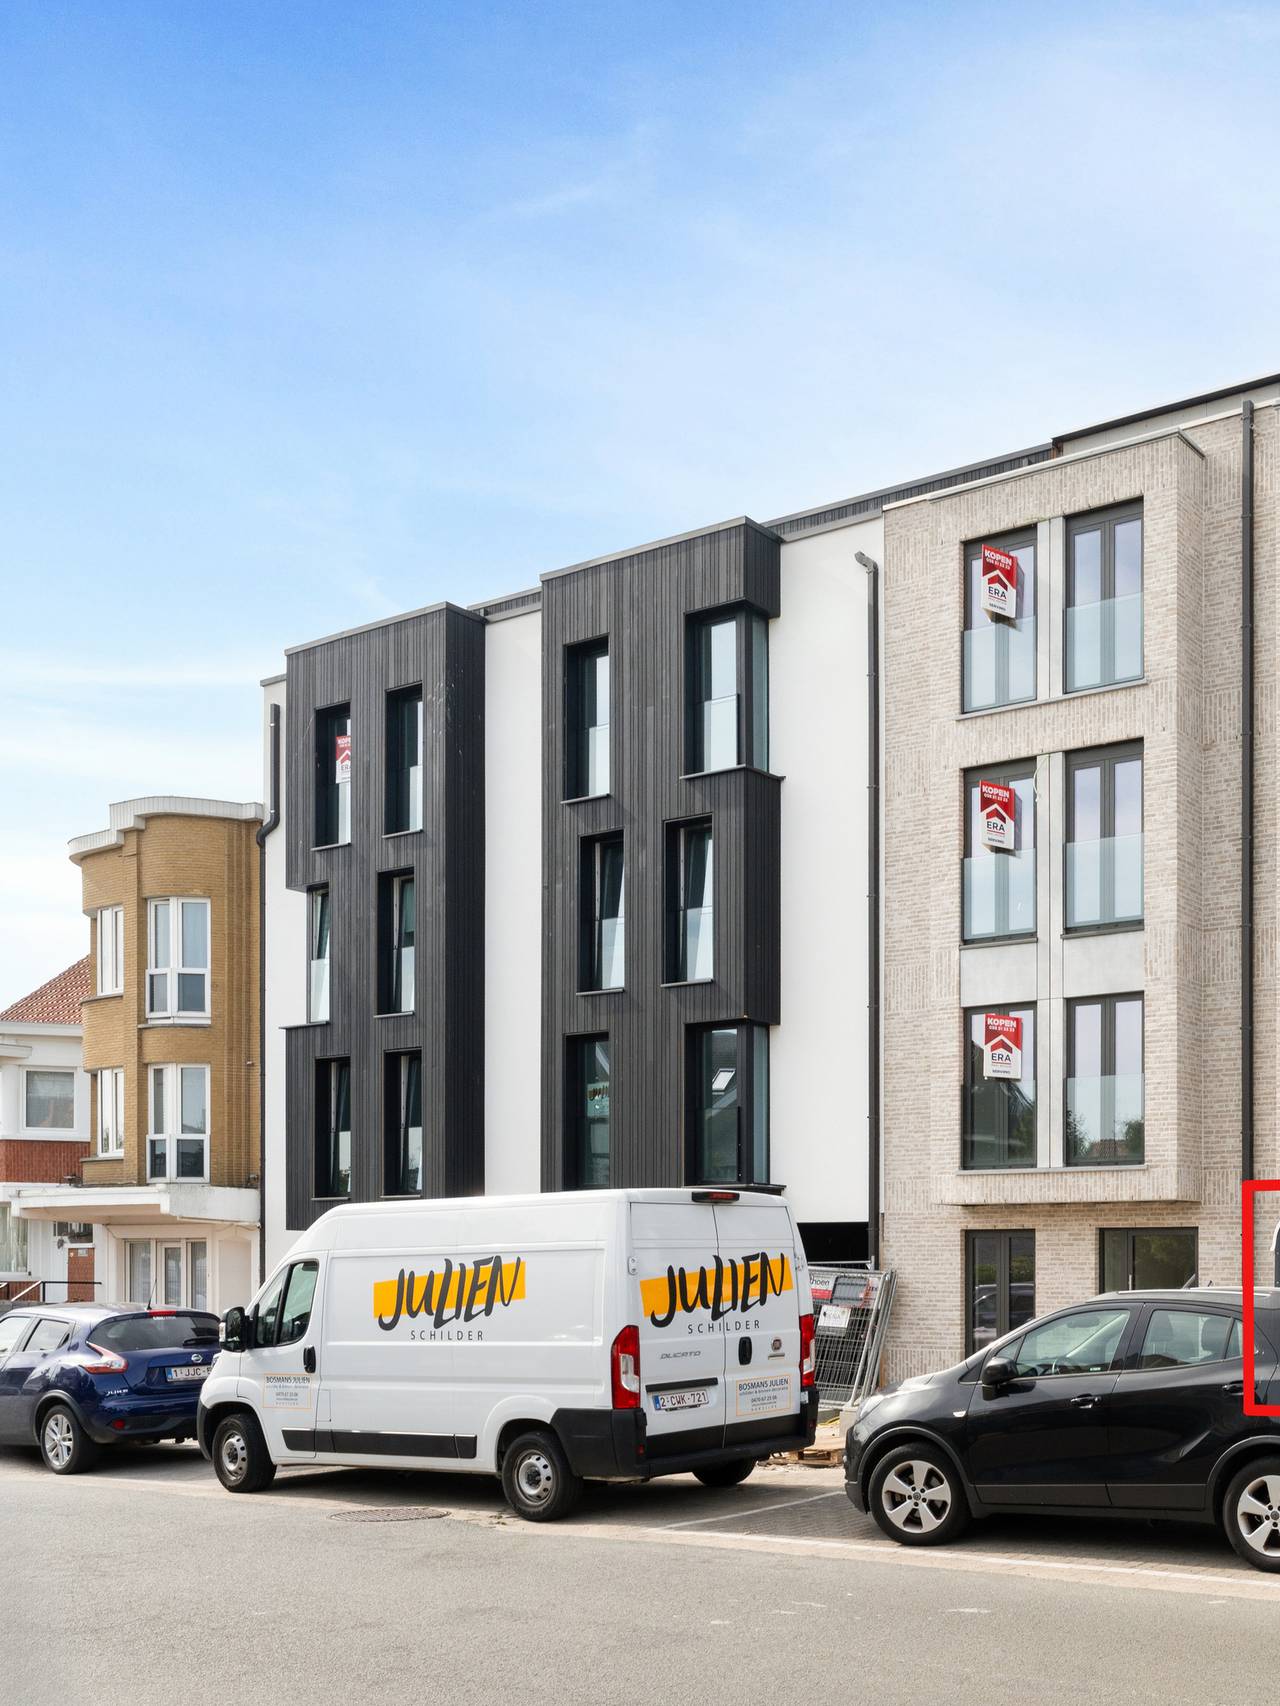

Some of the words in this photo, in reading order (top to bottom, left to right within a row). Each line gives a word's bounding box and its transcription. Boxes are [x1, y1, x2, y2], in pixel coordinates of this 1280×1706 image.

[984, 549, 1012, 566] KOPEN
[988, 586, 1007, 599] ERA
[982, 785, 1010, 798] KOPEN
[986, 821, 1005, 832] ERA
[987, 1017, 1017, 1028] KOPEN
[991, 1053, 1012, 1062] ERA
[378, 1255, 521, 1331] JULIEN
[650, 1251, 785, 1328] JULIEN
[688, 1320, 760, 1335] SCHILDER
[410, 1330, 483, 1341] SCHILDER
[266, 1376, 292, 1384] BOSMANS
[293, 1376, 311, 1384] JULIEN
[738, 1380, 768, 1391] BOSMANS
[769, 1378, 788, 1387] JULIEN
